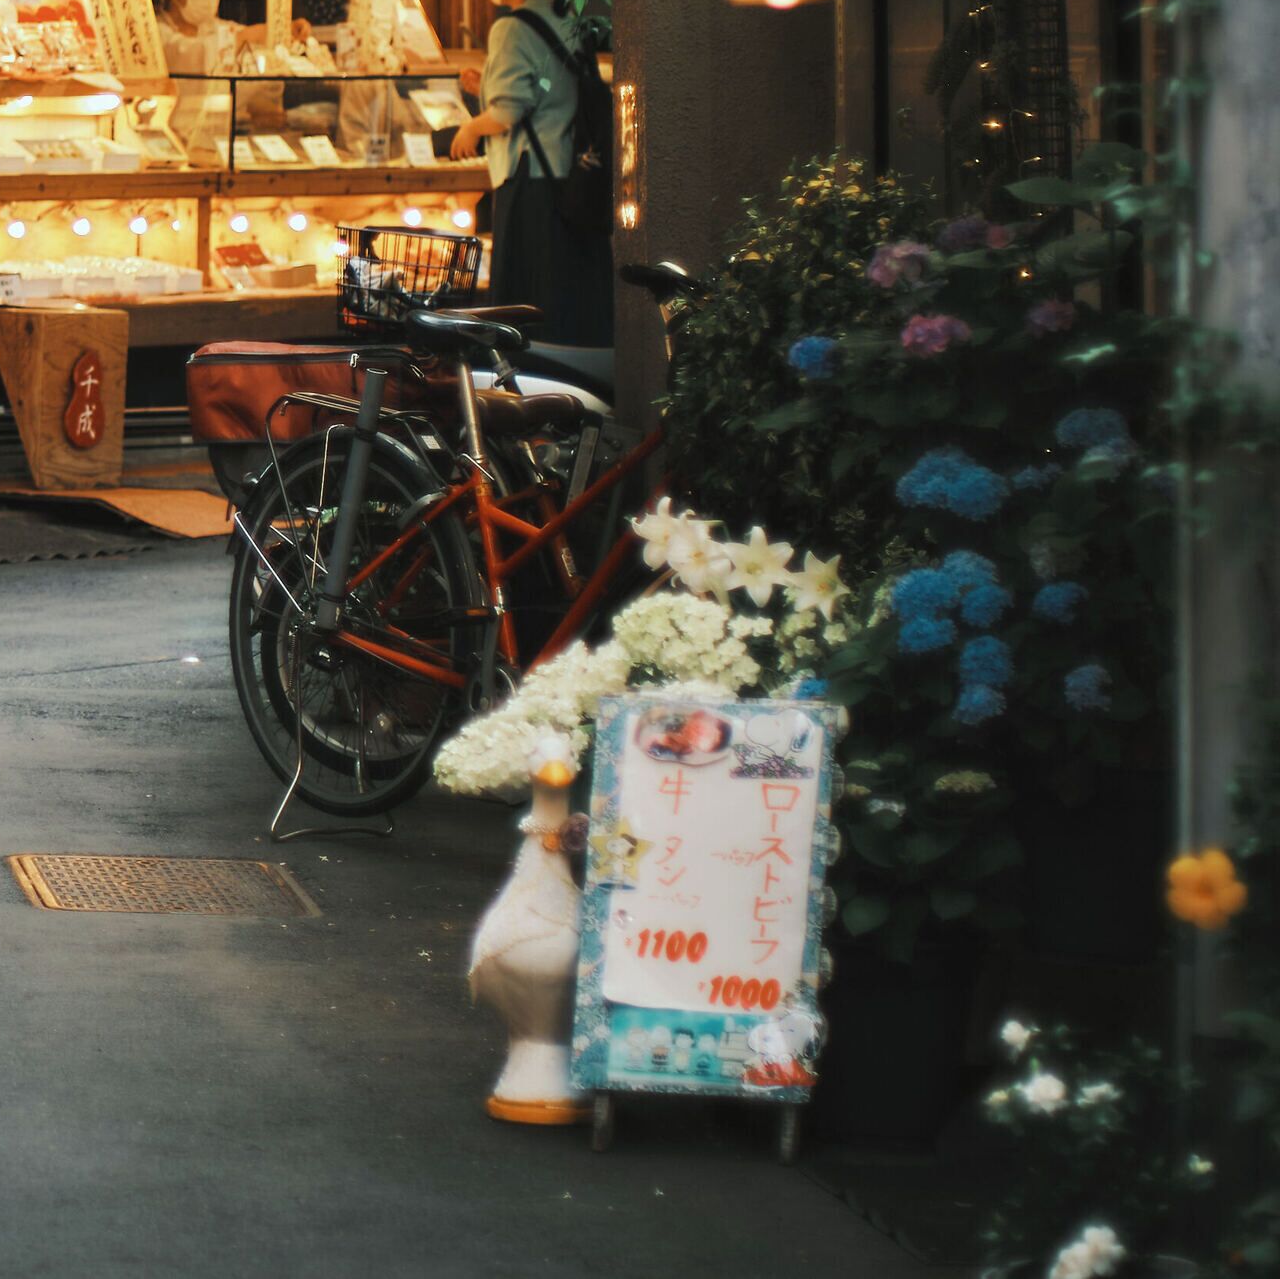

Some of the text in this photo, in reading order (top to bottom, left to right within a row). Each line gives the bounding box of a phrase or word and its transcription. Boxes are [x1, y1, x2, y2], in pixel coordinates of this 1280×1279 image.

[76, 365, 99, 439] 千成
[749, 782, 801, 965] ローストビーフ
